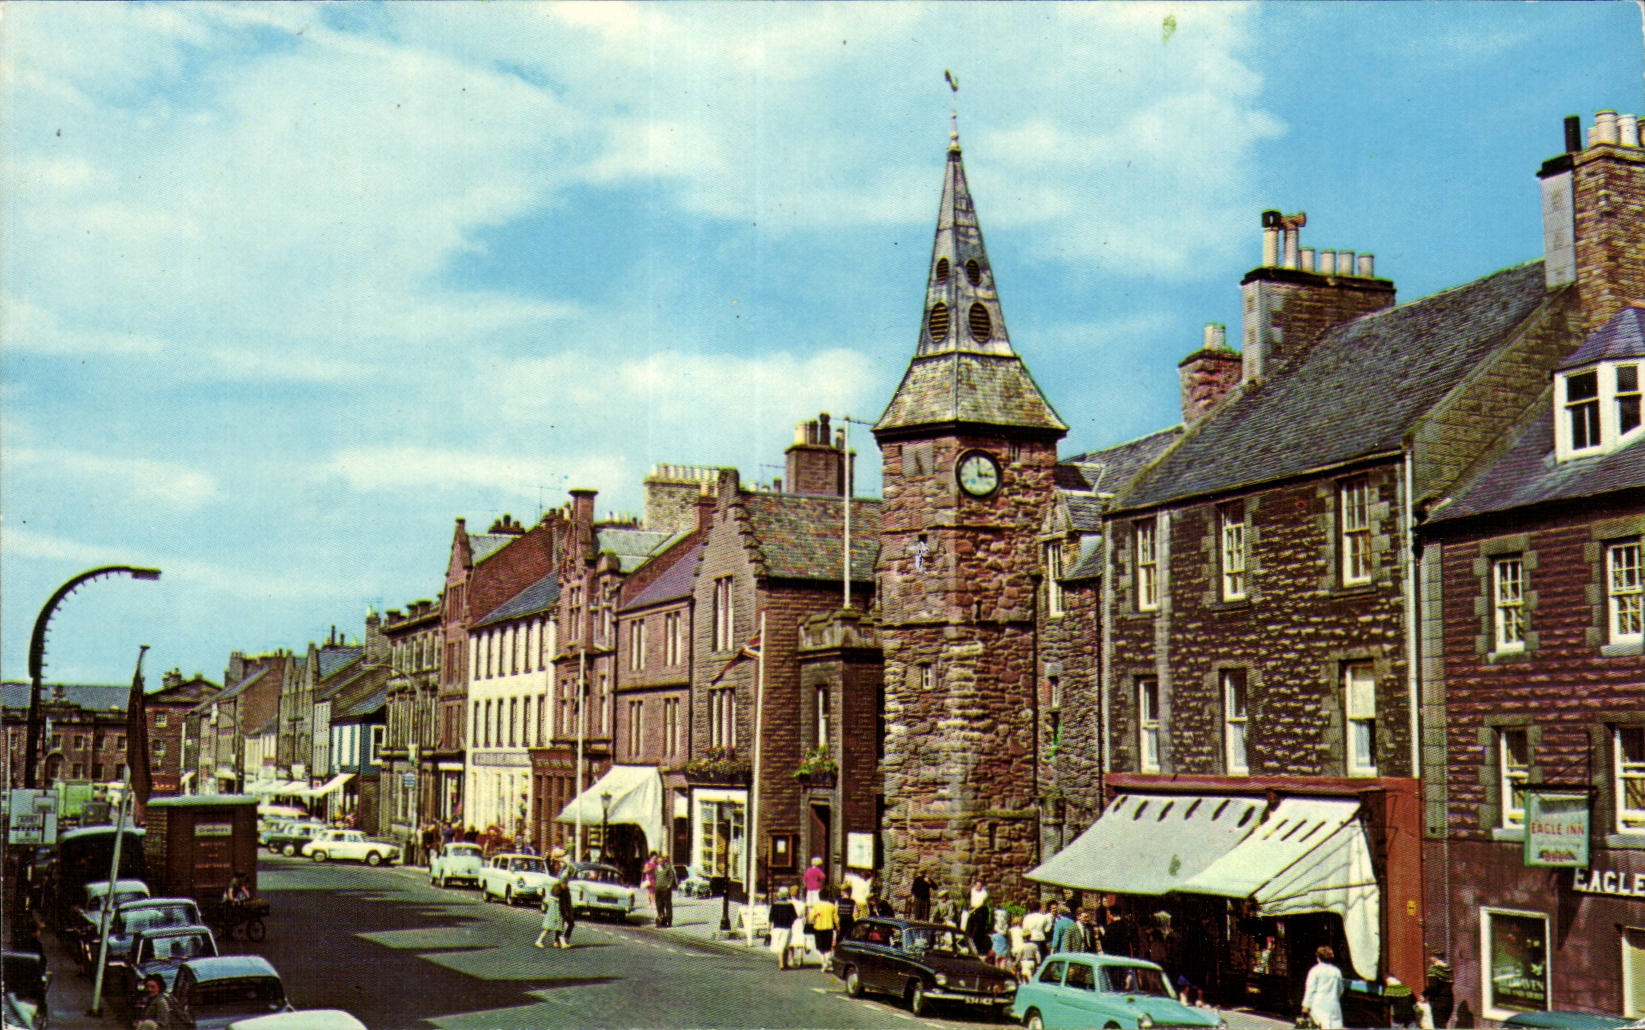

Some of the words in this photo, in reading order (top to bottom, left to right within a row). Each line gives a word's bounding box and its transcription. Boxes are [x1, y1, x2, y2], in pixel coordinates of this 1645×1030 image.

[1531, 821, 1562, 836] EAGLE
[1566, 822, 1585, 836] INN
[1572, 867, 1645, 898] EAGLE
